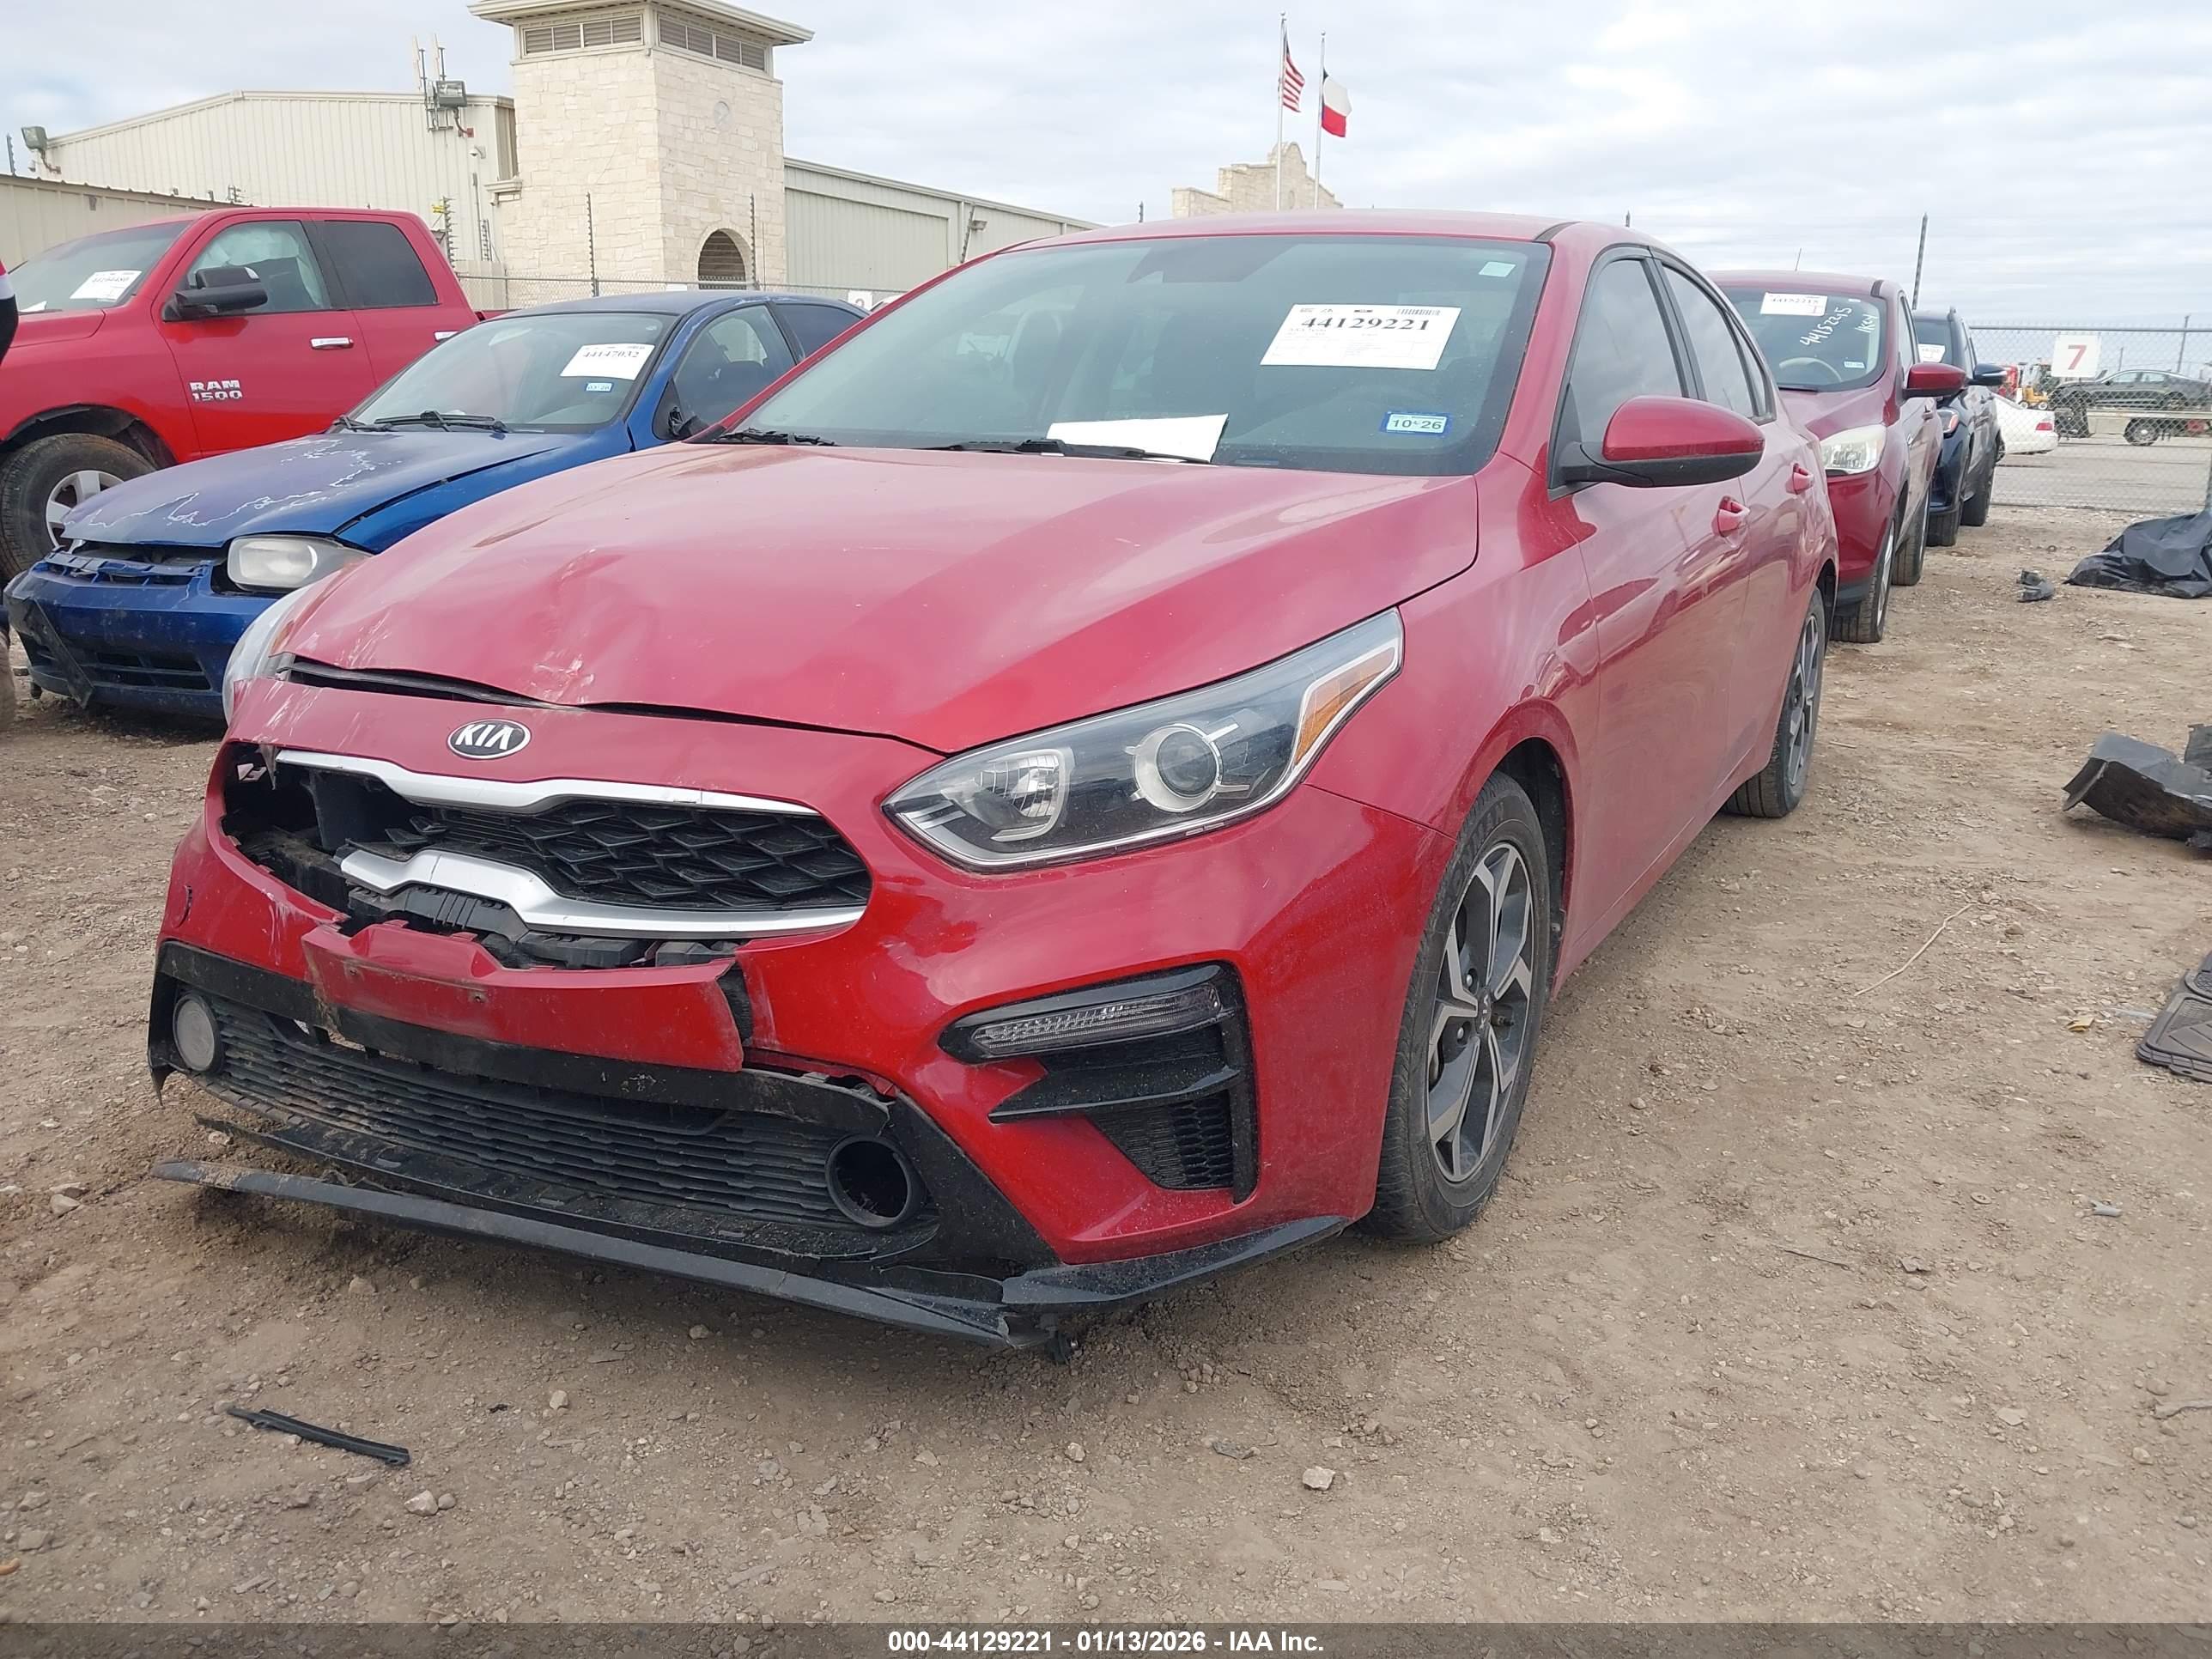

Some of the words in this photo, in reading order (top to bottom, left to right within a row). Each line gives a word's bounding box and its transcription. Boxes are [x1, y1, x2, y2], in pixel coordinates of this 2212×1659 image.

[1301, 317, 1430, 331] 44129221
[2068, 344, 2087, 370] 7
[189, 380, 240, 392] RAM
[191, 390, 243, 402] 1500
[1393, 419, 1413, 428] 10
[1420, 420, 1442, 429] 26
[454, 724, 514, 750] KIA
